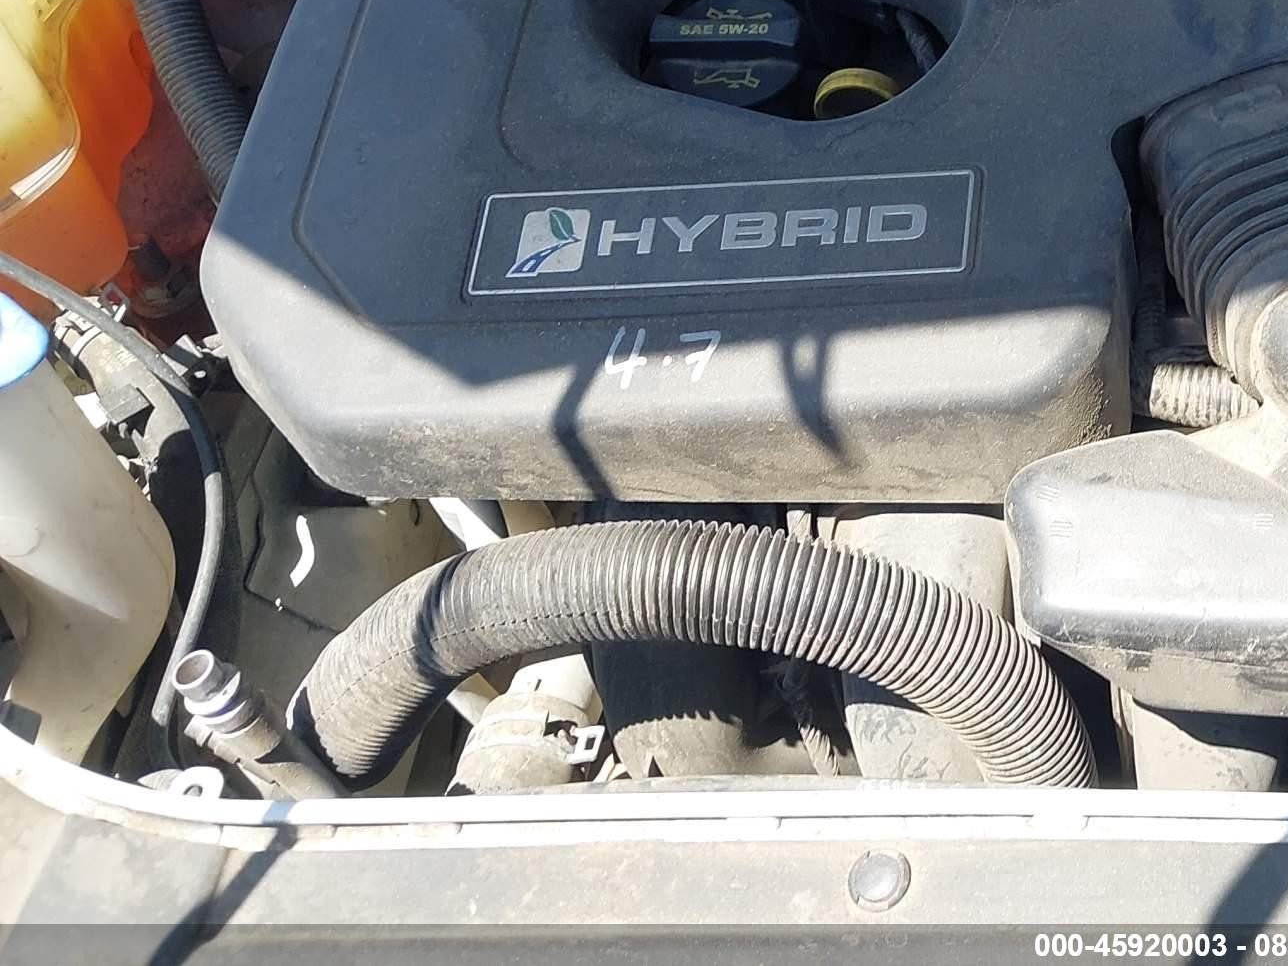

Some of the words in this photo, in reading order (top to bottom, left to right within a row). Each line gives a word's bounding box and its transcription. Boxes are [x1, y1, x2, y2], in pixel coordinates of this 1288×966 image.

[680, 24, 714, 36] SAE
[718, 23, 769, 35] 5W-20
[596, 203, 928, 257] HYBRID
